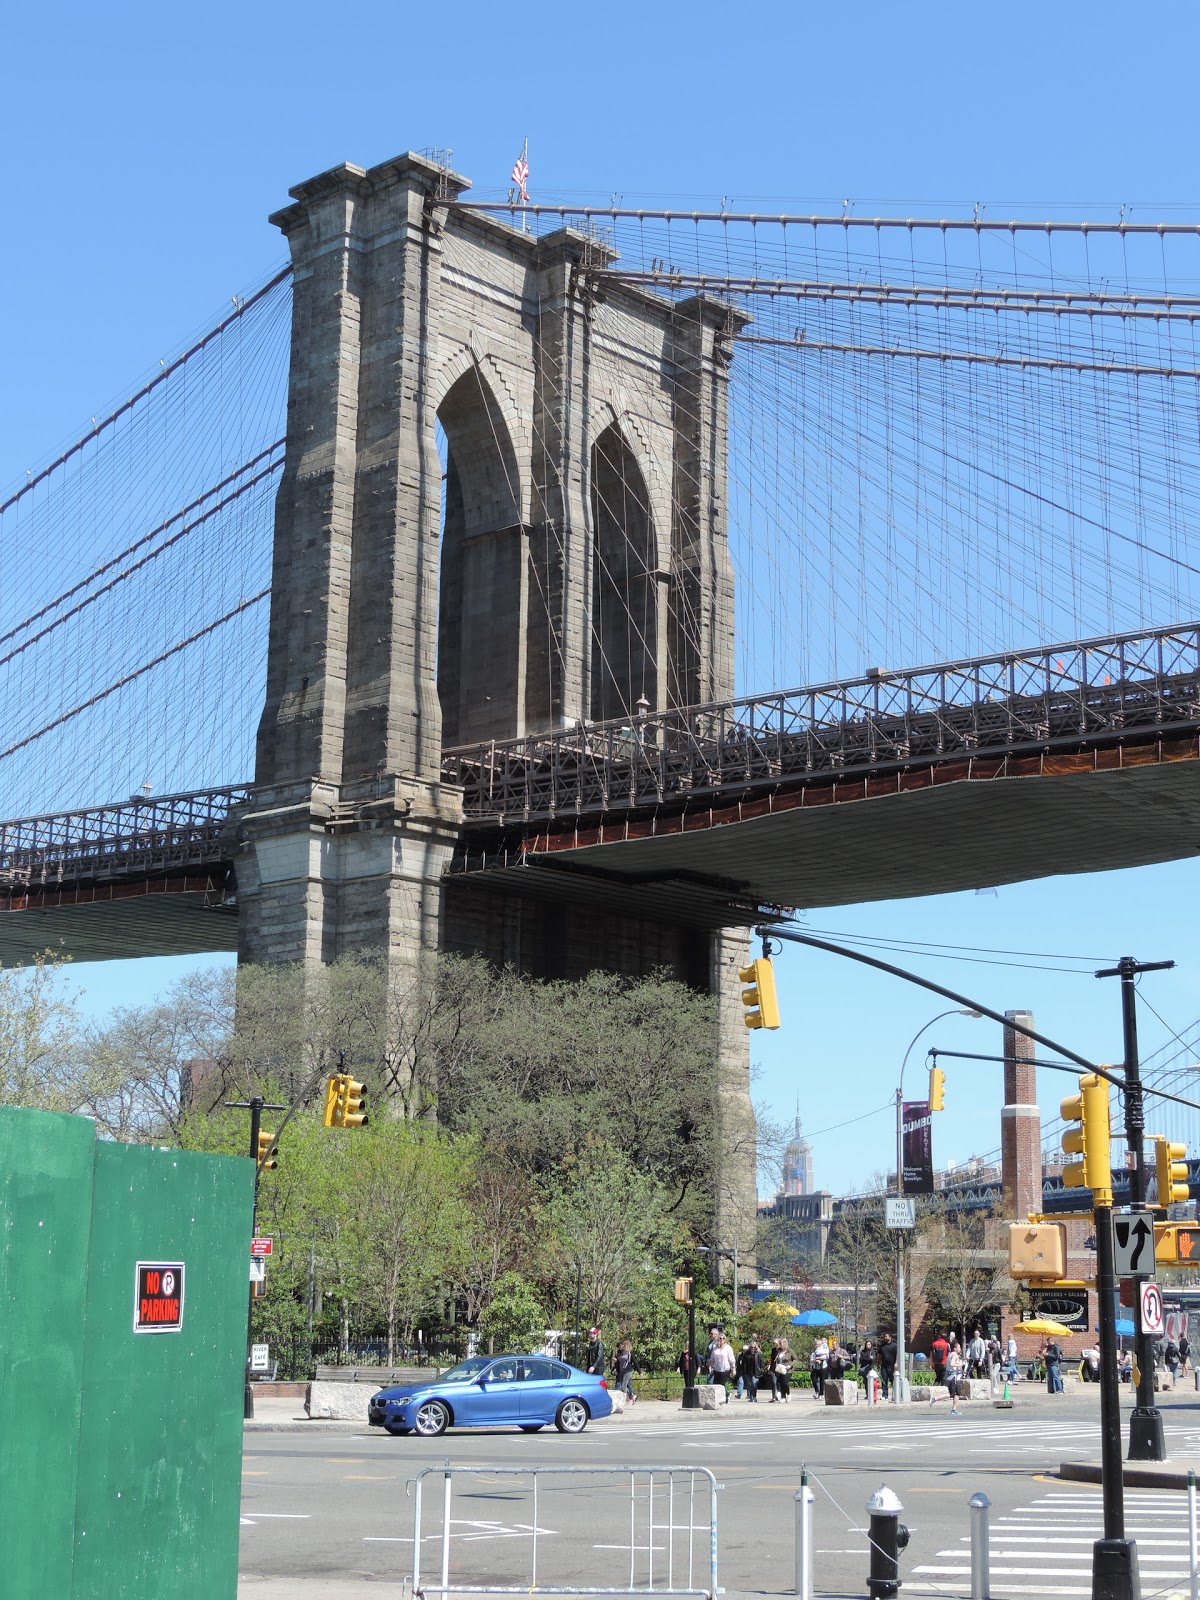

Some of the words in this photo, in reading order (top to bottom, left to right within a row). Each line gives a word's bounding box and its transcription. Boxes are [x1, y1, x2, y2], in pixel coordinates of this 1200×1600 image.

[903, 1115, 932, 1134] DUMBO
[895, 1202, 906, 1210] NO
[146, 1272, 160, 1294] NO
[140, 1299, 178, 1321] PARKING
